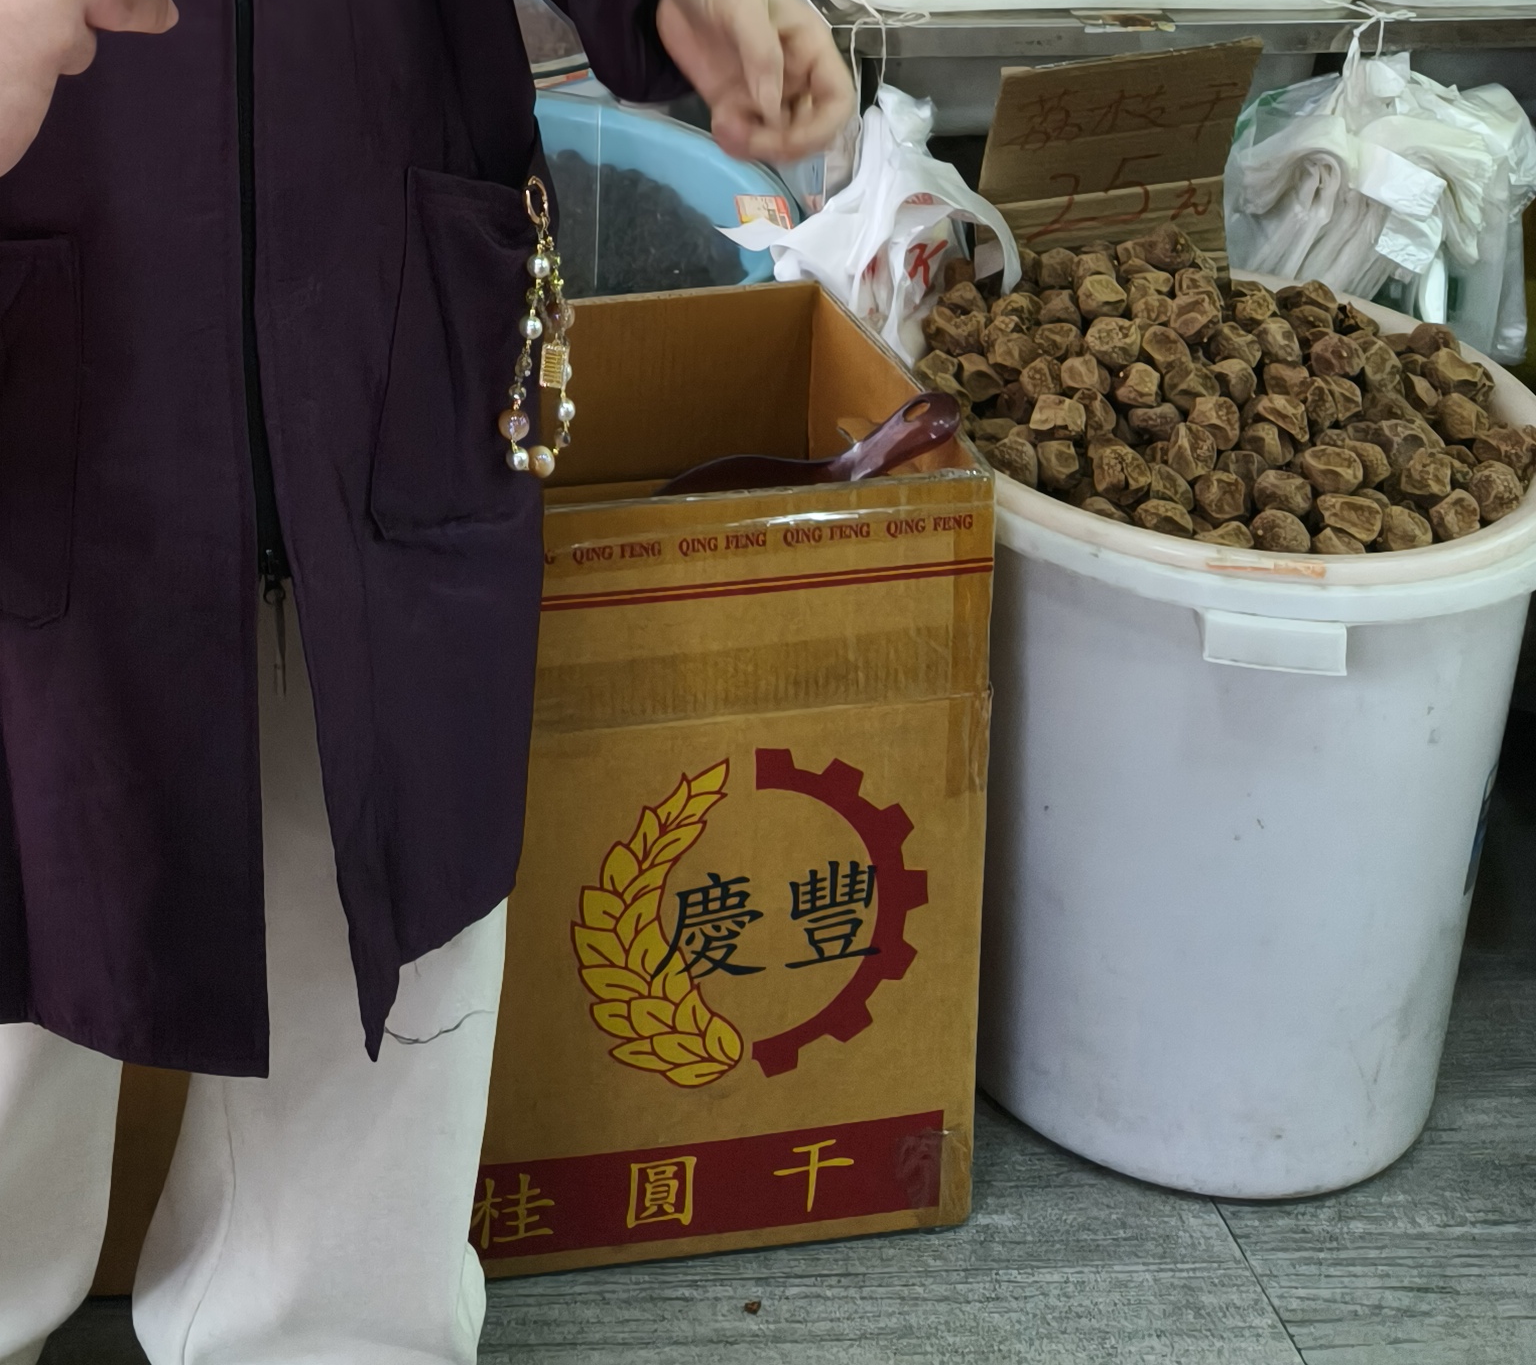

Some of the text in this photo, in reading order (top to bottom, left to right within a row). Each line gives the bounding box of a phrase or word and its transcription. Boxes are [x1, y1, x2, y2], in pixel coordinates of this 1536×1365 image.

[571, 545, 614, 566] QING
[619, 541, 663, 561] FENG
[677, 536, 719, 558] QING
[723, 531, 768, 551] FENG
[782, 527, 823, 548] QING
[827, 521, 871, 541] FENG
[885, 518, 927, 539] QING
[931, 513, 974, 533] FENG
[649, 860, 882, 981] 慶豐
[473, 1138, 854, 1249] 桂圓干
